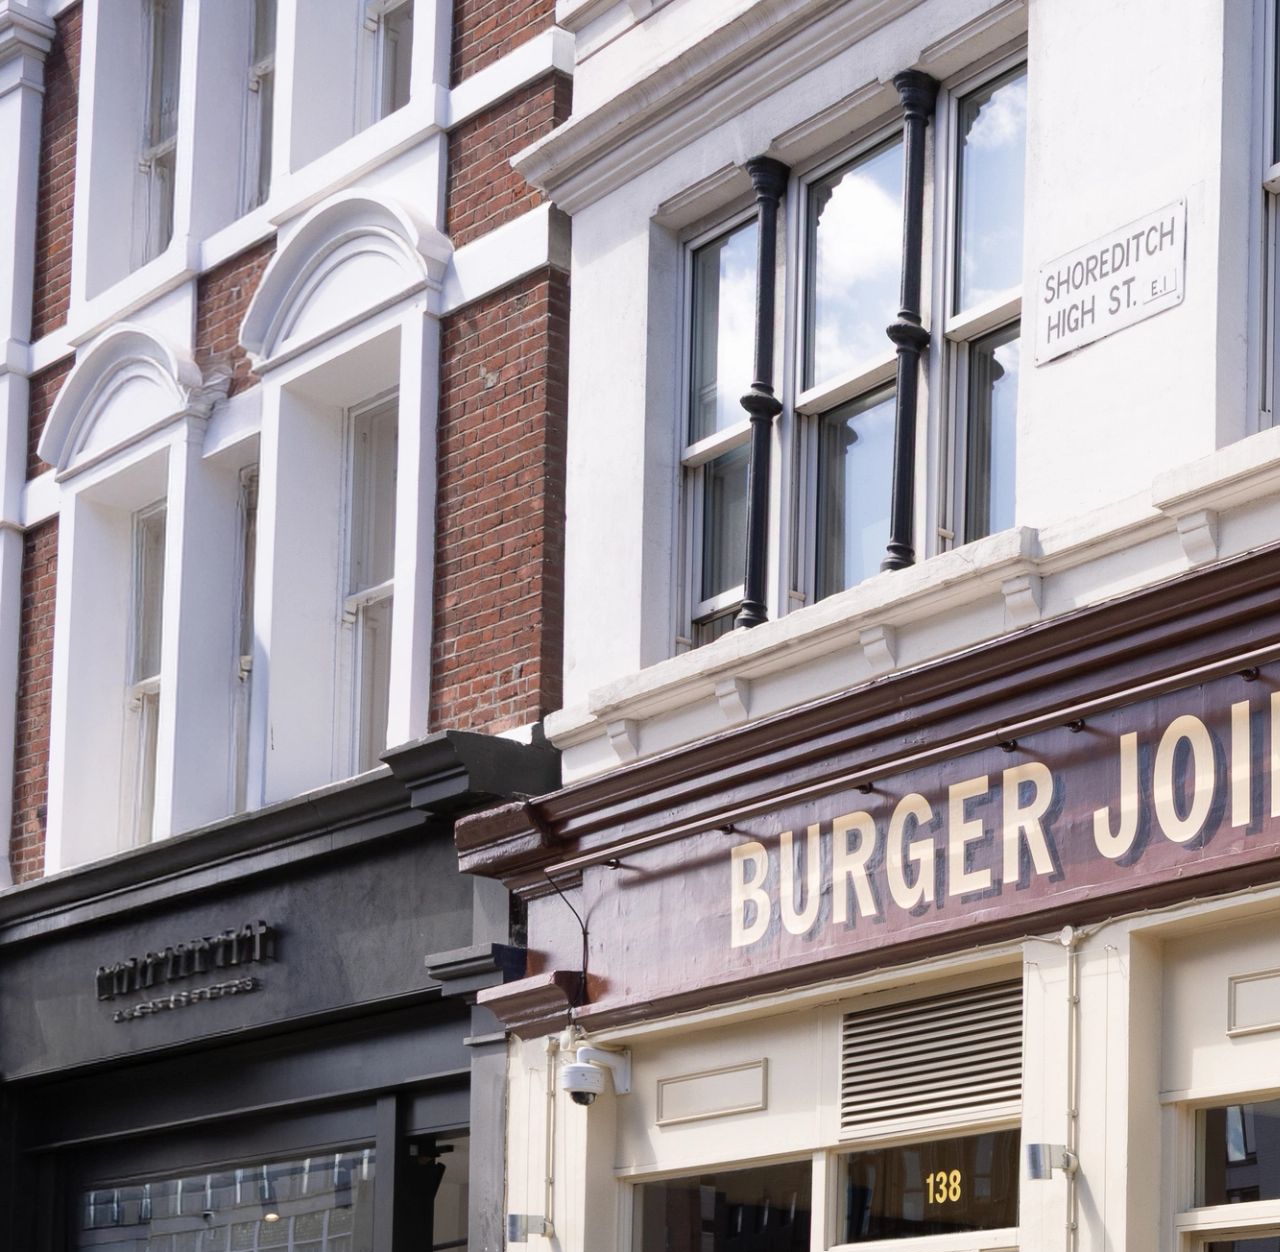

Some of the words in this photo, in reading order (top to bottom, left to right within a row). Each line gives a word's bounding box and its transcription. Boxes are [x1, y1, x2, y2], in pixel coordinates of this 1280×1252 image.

[1044, 216, 1176, 304] SHOREDITCH
[1047, 295, 1095, 344] HIGH
[1108, 276, 1137, 316] ST.
[730, 761, 1054, 949] BURGER
[925, 1170, 962, 1204] 138
